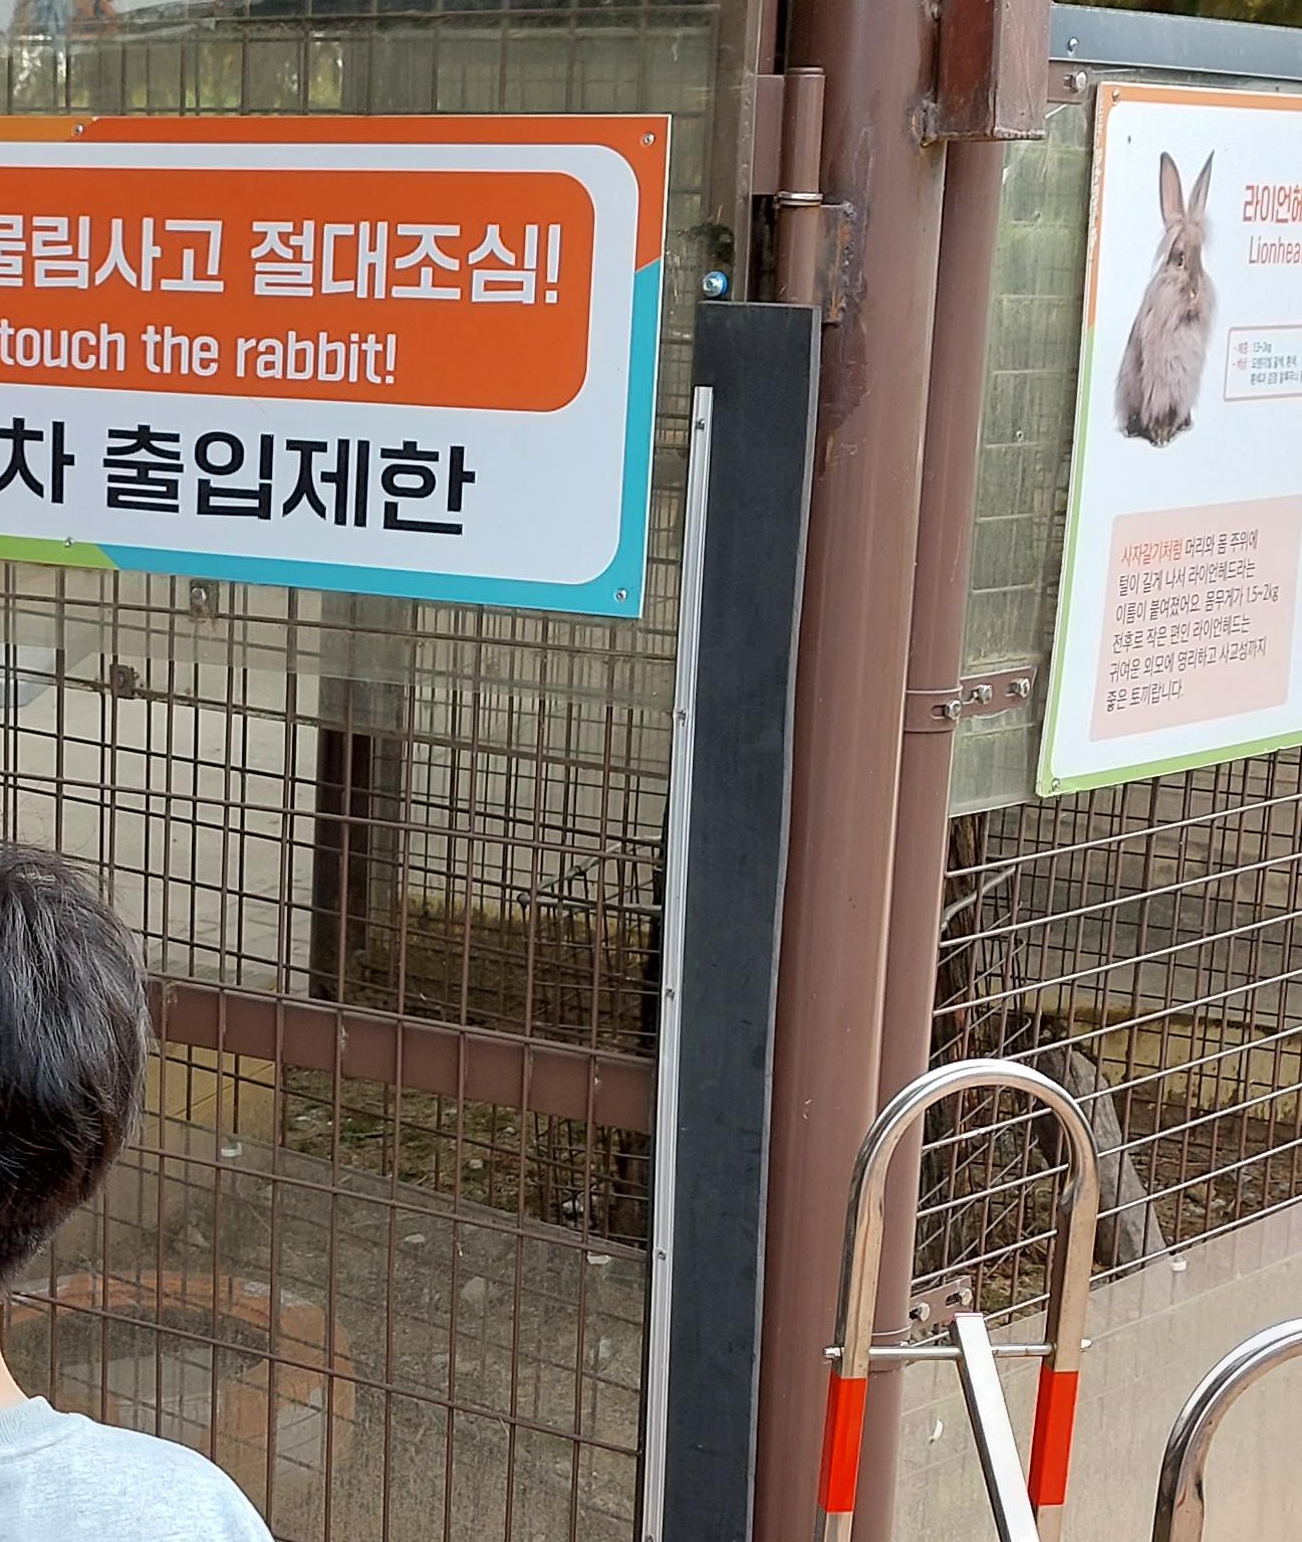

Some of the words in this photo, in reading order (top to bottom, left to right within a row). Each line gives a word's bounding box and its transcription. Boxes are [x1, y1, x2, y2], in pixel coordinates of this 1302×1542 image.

[249, 219, 562, 306] 절대조심!
[141, 324, 219, 377] the
[235, 329, 398, 385] rabbit!
[102, 423, 477, 537] 출입제한
[1121, 538, 1184, 568] 사자갈기처럼
[1184, 533, 1216, 559] 머리와
[1217, 533, 1228, 556] 몸
[1229, 529, 1259, 553] 주위에
[1118, 572, 1140, 597] 털이
[1142, 570, 1163, 594] 길게
[1165, 565, 1187, 590] 나서
[1188, 557, 1256, 587] 라이언헤드라는
[1116, 601, 1148, 626] 이름이
[1205, 585, 1244, 613] 몸무게가
[1111, 630, 1144, 655] 전후로
[1146, 625, 1167, 649] 작은
[1169, 620, 1190, 646] 편인
[1192, 613, 1252, 641] 라이언헤드는
[1109, 657, 1142, 684] 귀여운
[1143, 651, 1176, 677] 외모에
[1177, 645, 1218, 673] 영리하고
[1219, 635, 1268, 665] 사교성까지
[1106, 688, 1128, 714] 좋은
